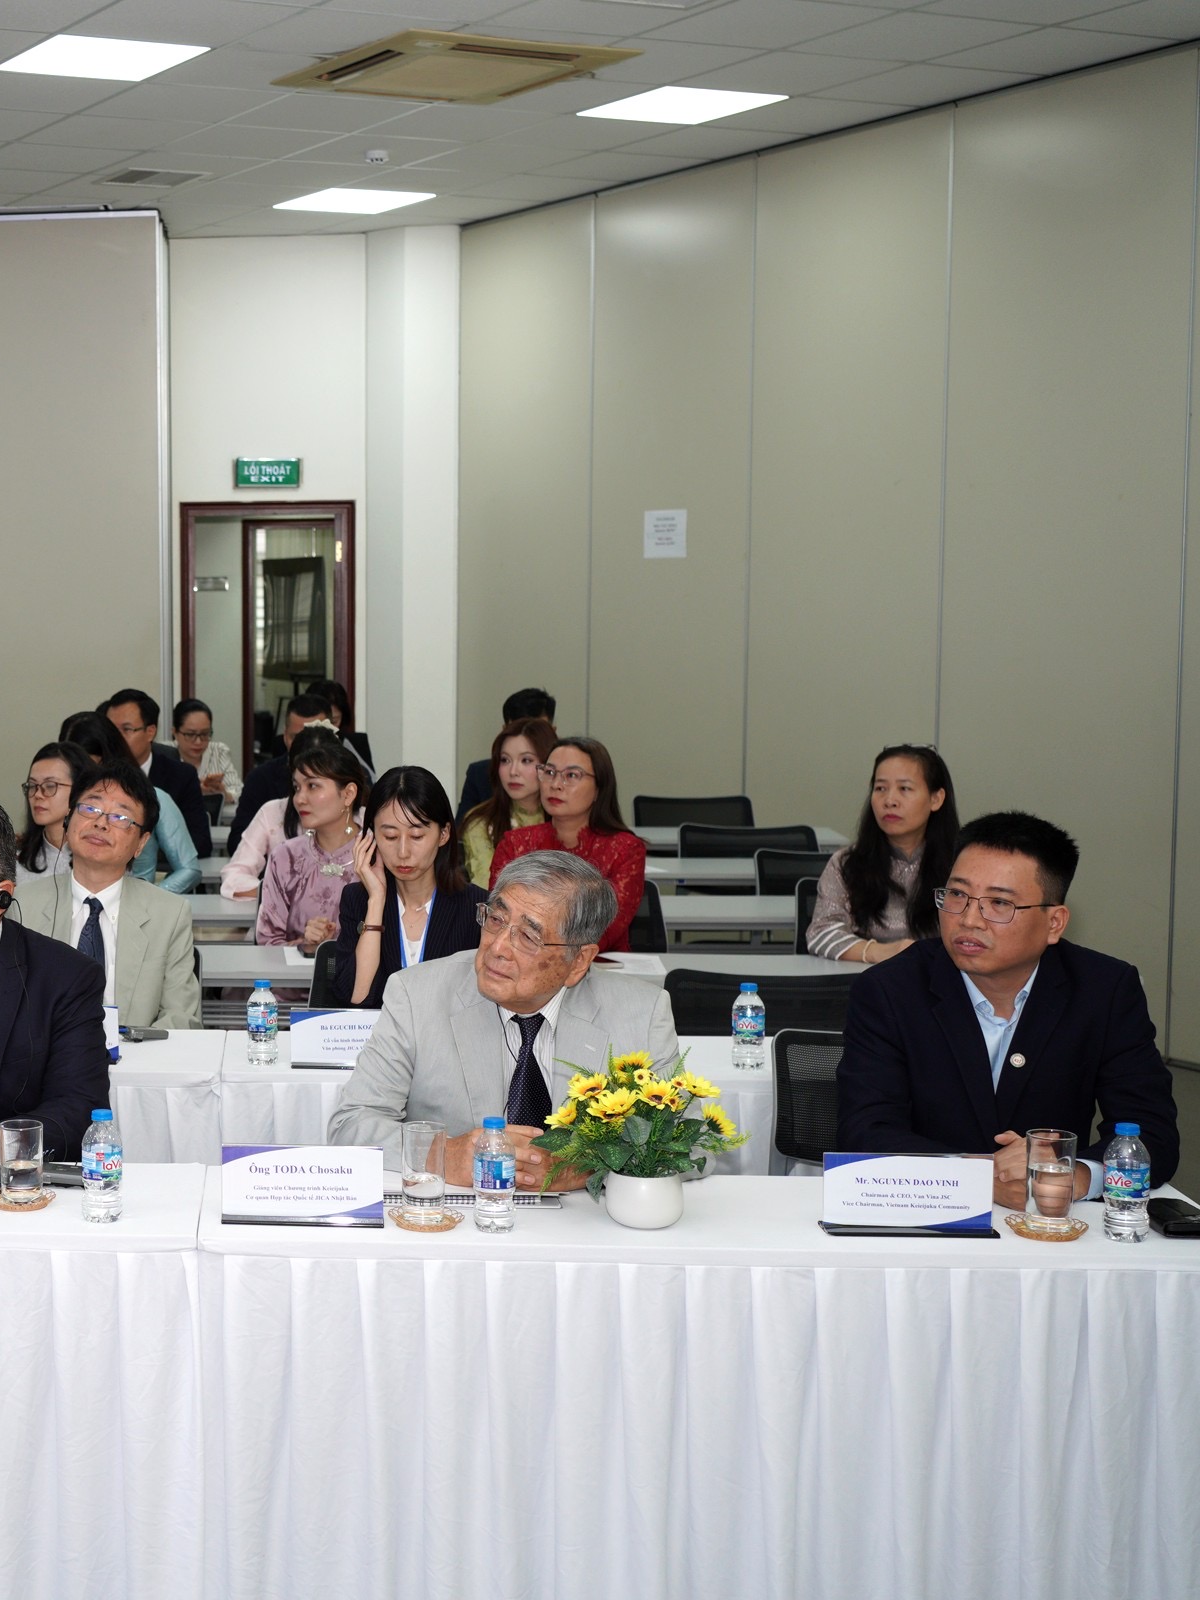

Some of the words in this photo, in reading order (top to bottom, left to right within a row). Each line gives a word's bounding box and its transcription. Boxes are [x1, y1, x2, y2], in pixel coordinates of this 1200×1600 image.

[261, 463, 291, 475] THOÁT
[249, 1162, 271, 1175] Ông
[272, 1165, 306, 1175] TODA
[309, 1165, 353, 1175] Chosaku
[855, 1177, 869, 1185] Mr.
[872, 1177, 911, 1186] NGUYEN
